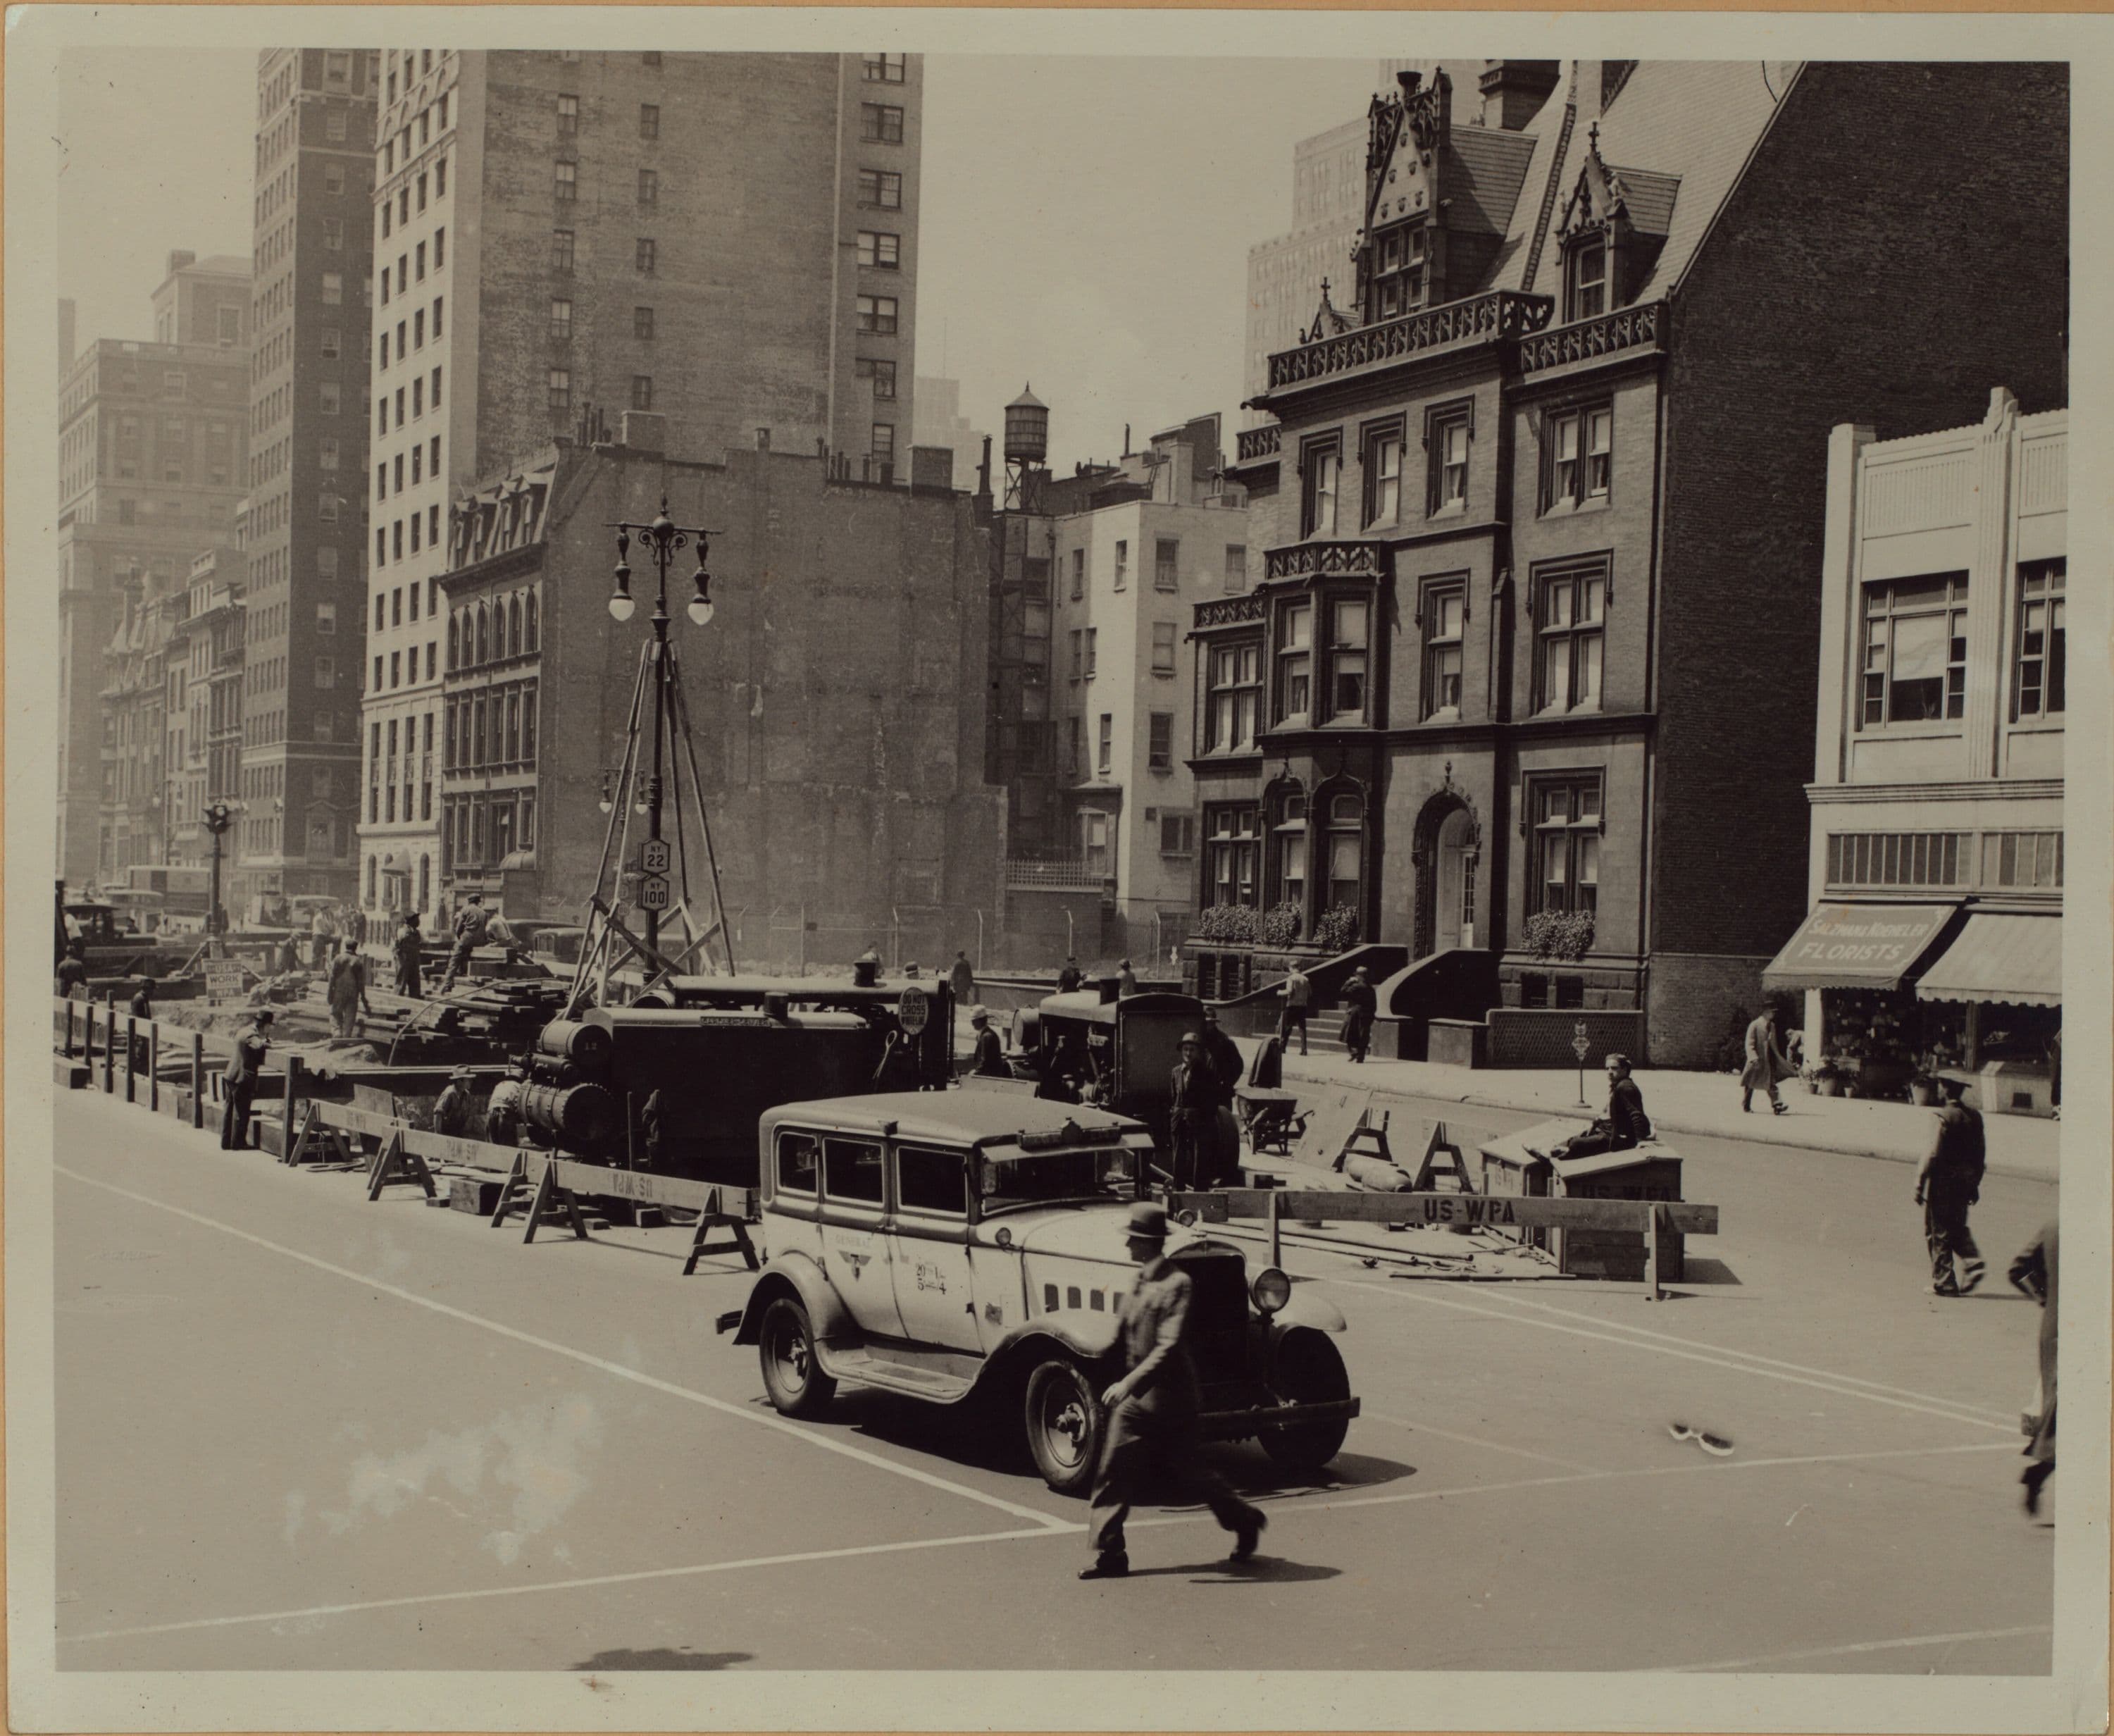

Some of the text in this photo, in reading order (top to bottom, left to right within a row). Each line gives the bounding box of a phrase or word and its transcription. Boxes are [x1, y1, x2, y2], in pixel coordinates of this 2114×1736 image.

[647, 855, 664, 867] 22
[645, 891, 665, 903] 100
[1798, 942, 1905, 960] FLORISTS
[210, 974, 239, 984] WORK
[903, 993, 925, 1004] DO NOT
[901, 1005, 925, 1015] CROSS
[1424, 1198, 1515, 1224] US-WPA
